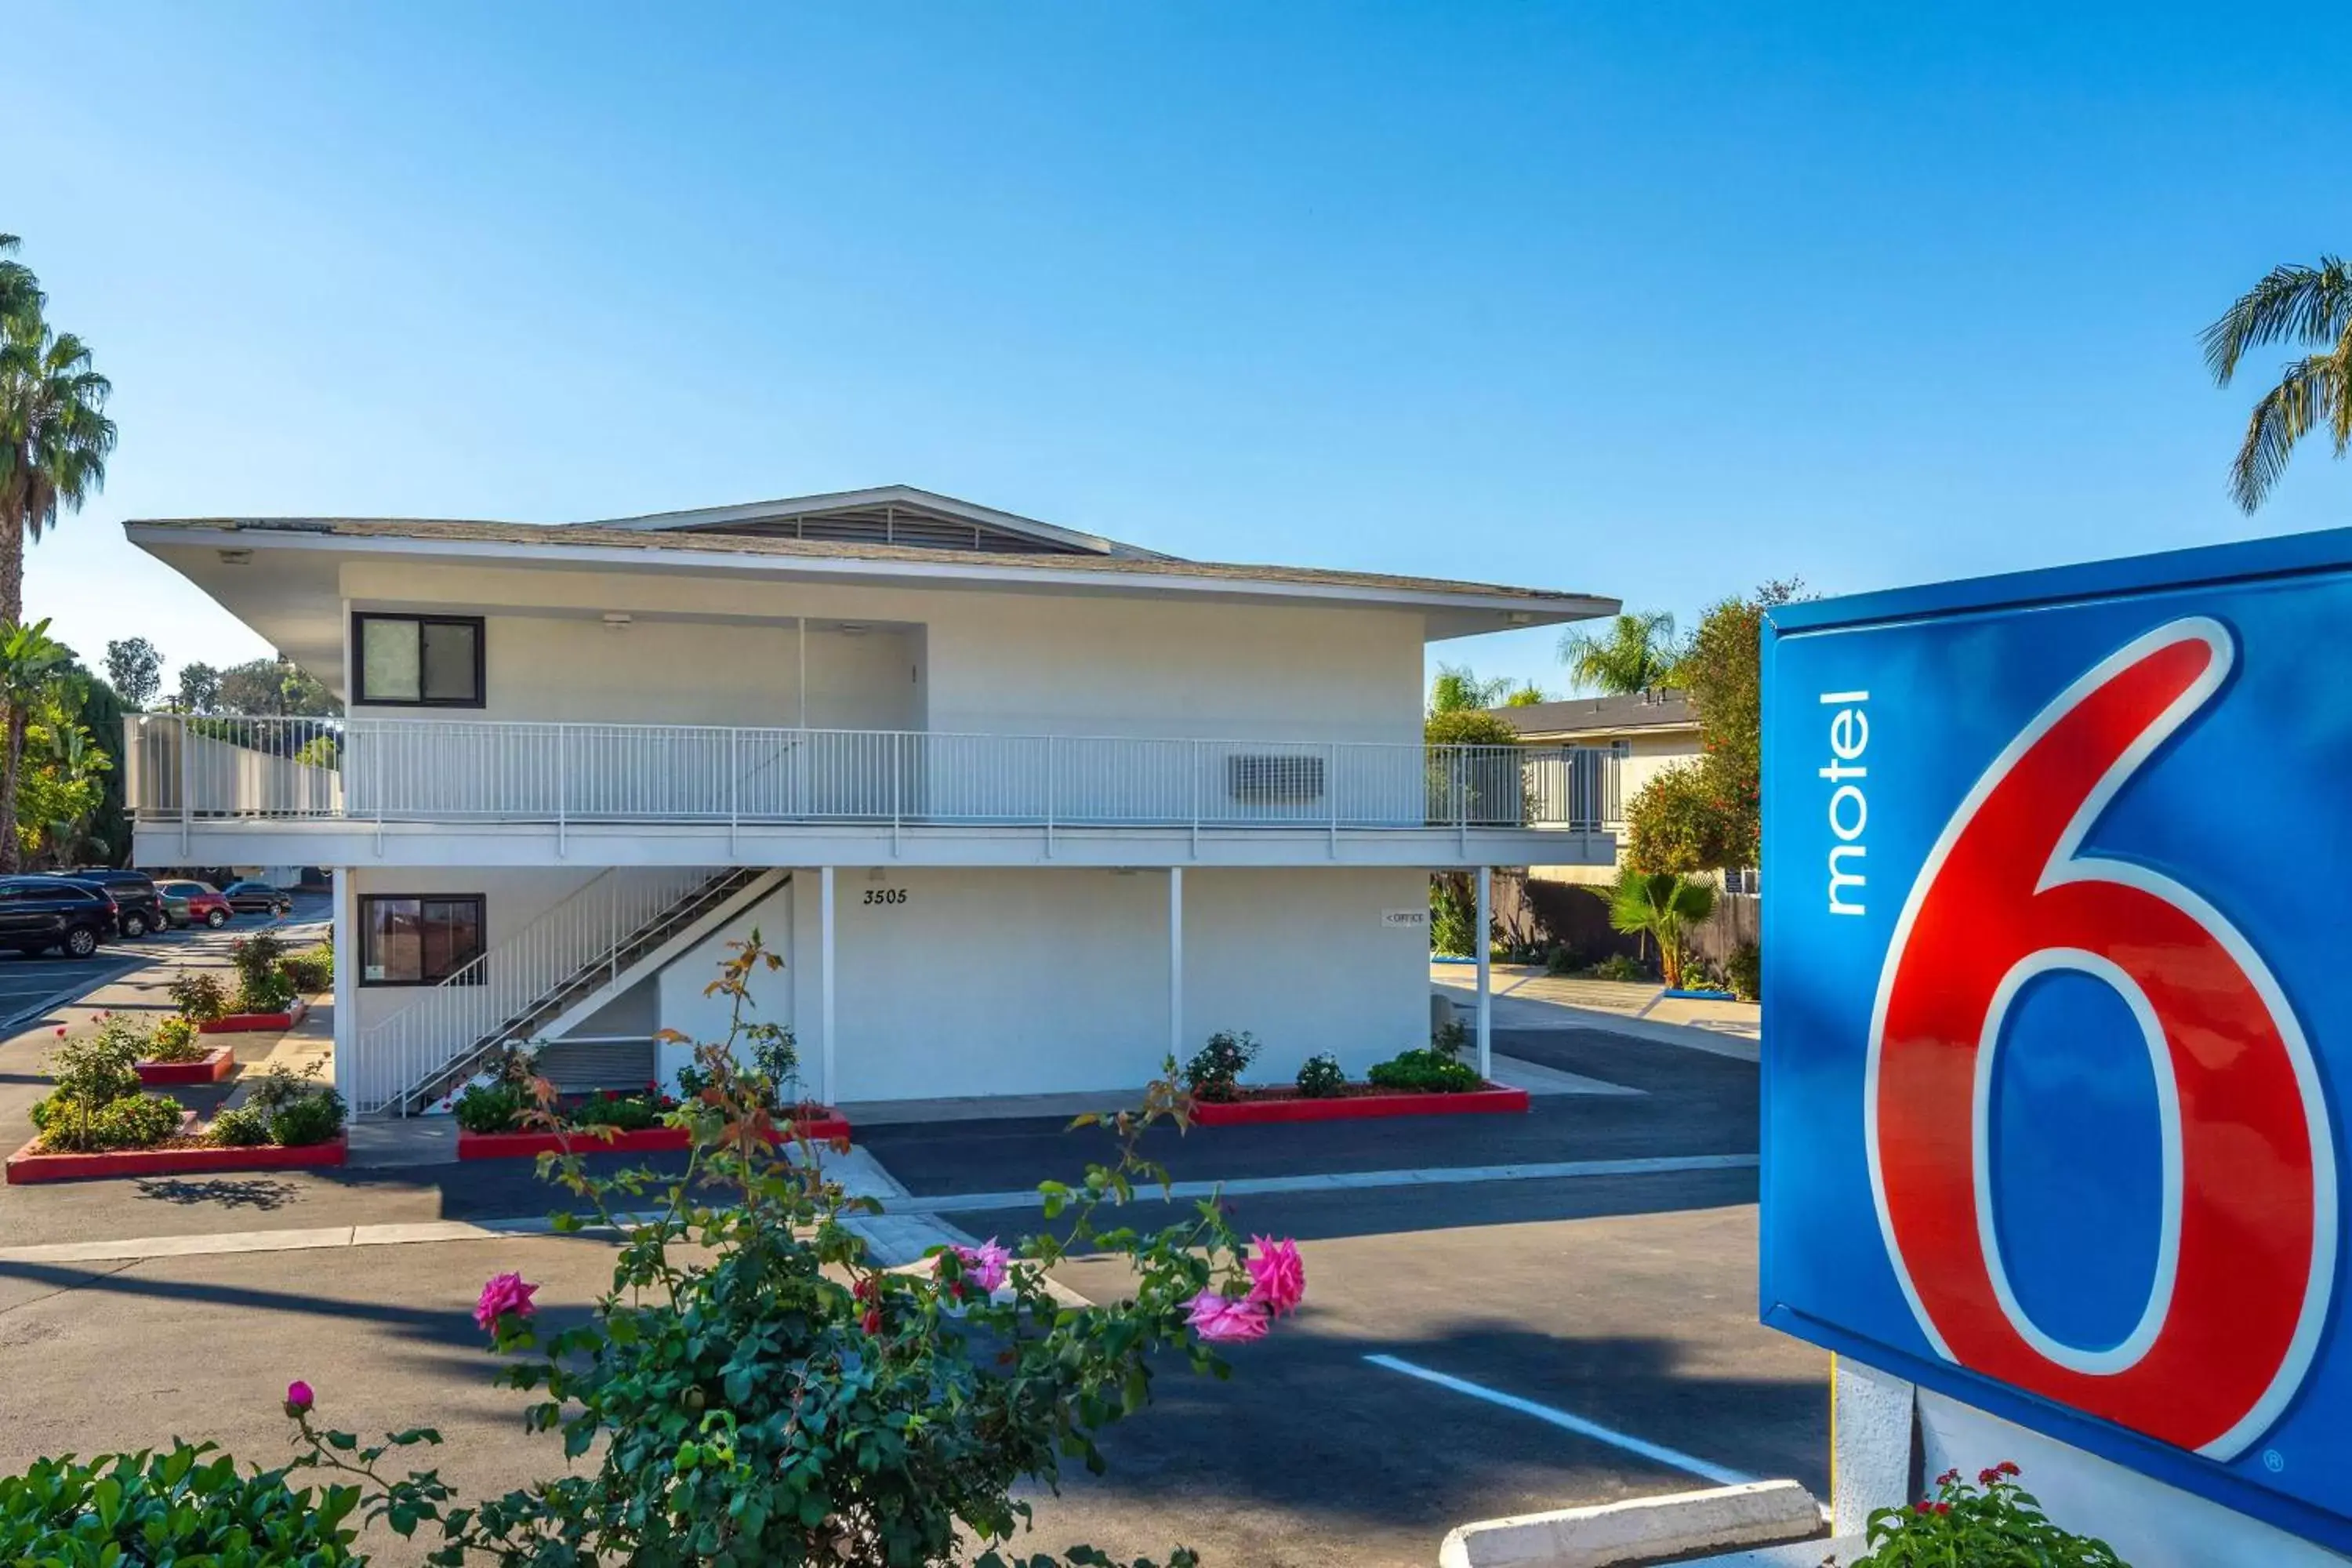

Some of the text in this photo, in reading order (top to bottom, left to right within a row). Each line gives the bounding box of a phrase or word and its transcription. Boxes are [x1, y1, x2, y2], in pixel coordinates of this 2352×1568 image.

[863, 888, 908, 905] 3505
[1819, 690, 1869, 916] motel
[1864, 616, 2339, 1461] 6
